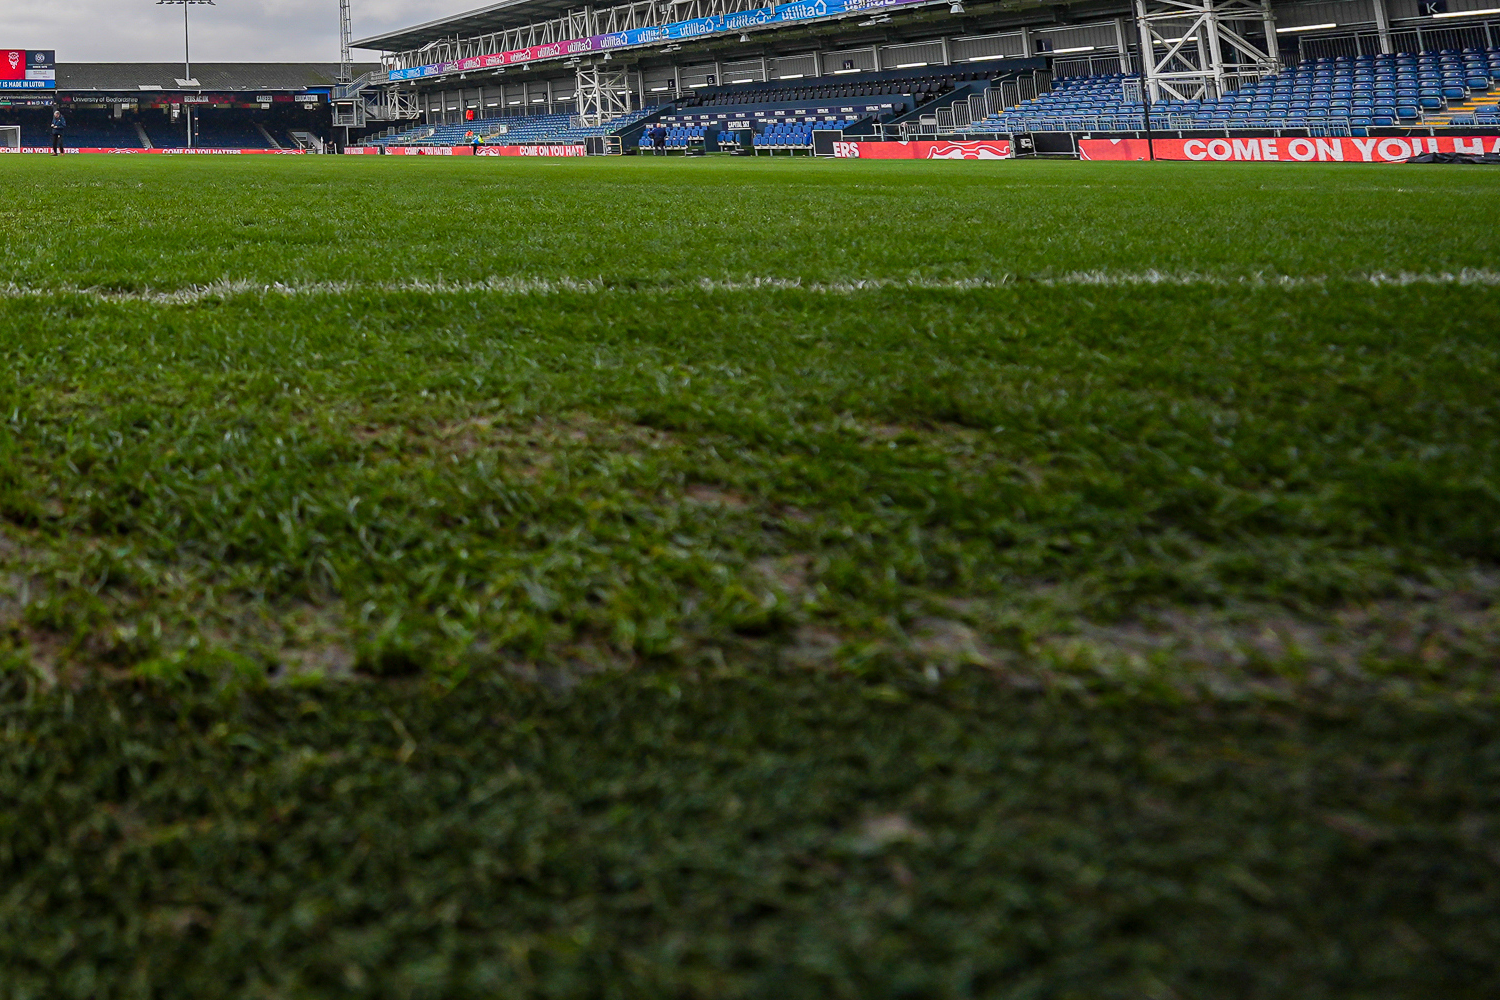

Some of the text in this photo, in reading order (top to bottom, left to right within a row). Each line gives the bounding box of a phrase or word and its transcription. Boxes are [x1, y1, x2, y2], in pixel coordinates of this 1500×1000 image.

[782, 4, 815, 20] utilita
[1426, 2, 1438, 14] K
[726, 14, 757, 30] utilita
[680, 22, 706, 37] utilita
[568, 41, 586, 52] utilita
[601, 36, 622, 48] utilita
[538, 46, 554, 58] utilita
[404, 147, 418, 155] COME
[425, 147, 433, 155] YOU
[434, 147, 452, 155] HATTERS
[519, 146, 537, 156] COME
[539, 146, 549, 156] ON
[550, 146, 564, 156] YOU
[1184, 138, 1278, 160] COME
[1287, 138, 1344, 162] ON
[1350, 138, 1438, 161] YOU
